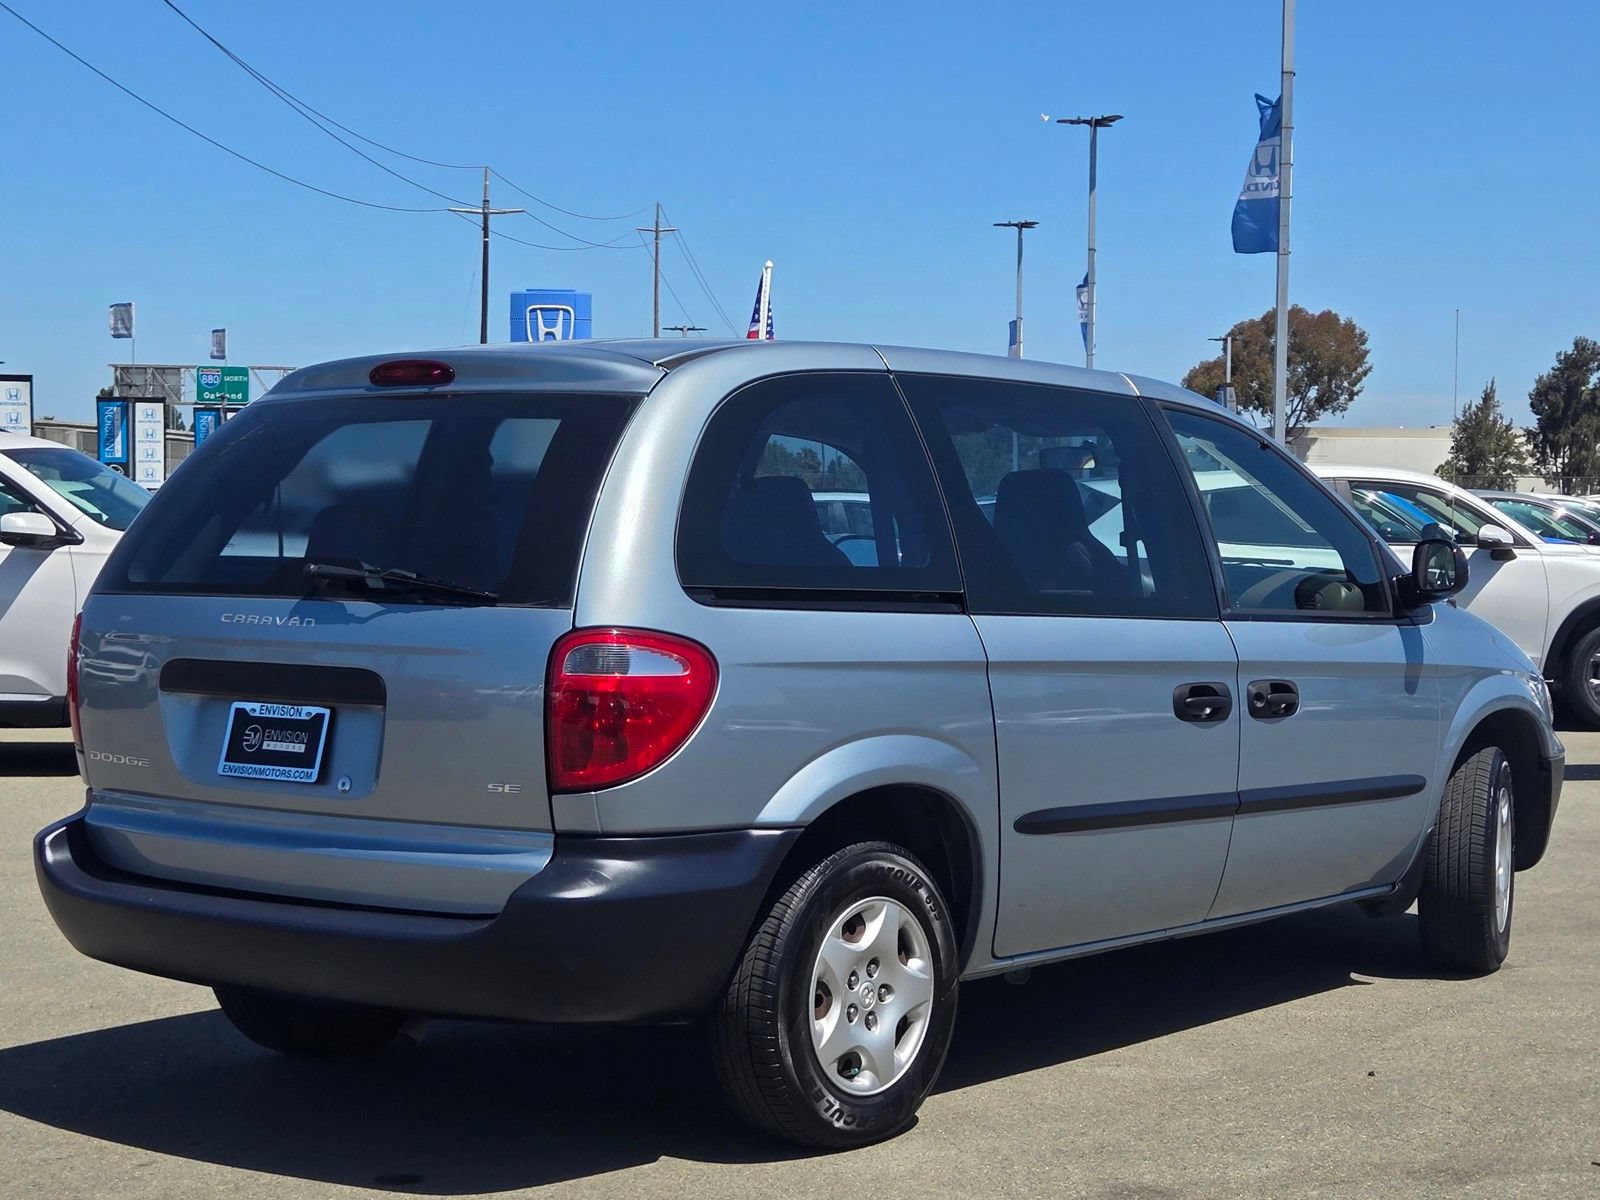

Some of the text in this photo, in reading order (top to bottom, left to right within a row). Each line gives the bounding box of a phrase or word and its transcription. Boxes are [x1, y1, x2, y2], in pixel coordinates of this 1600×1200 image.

[201, 374, 220, 384] 880
[203, 391, 243, 400] Oakand
[103, 406, 115, 458] ENVISION
[220, 613, 316, 627] CARAVAN
[259, 704, 303, 718] ENVISION
[264, 728, 309, 744] ENVISION
[90, 750, 151, 767] DODGE
[222, 765, 313, 780] ENVISIONMOTORS.COM
[487, 783, 522, 794] SE
